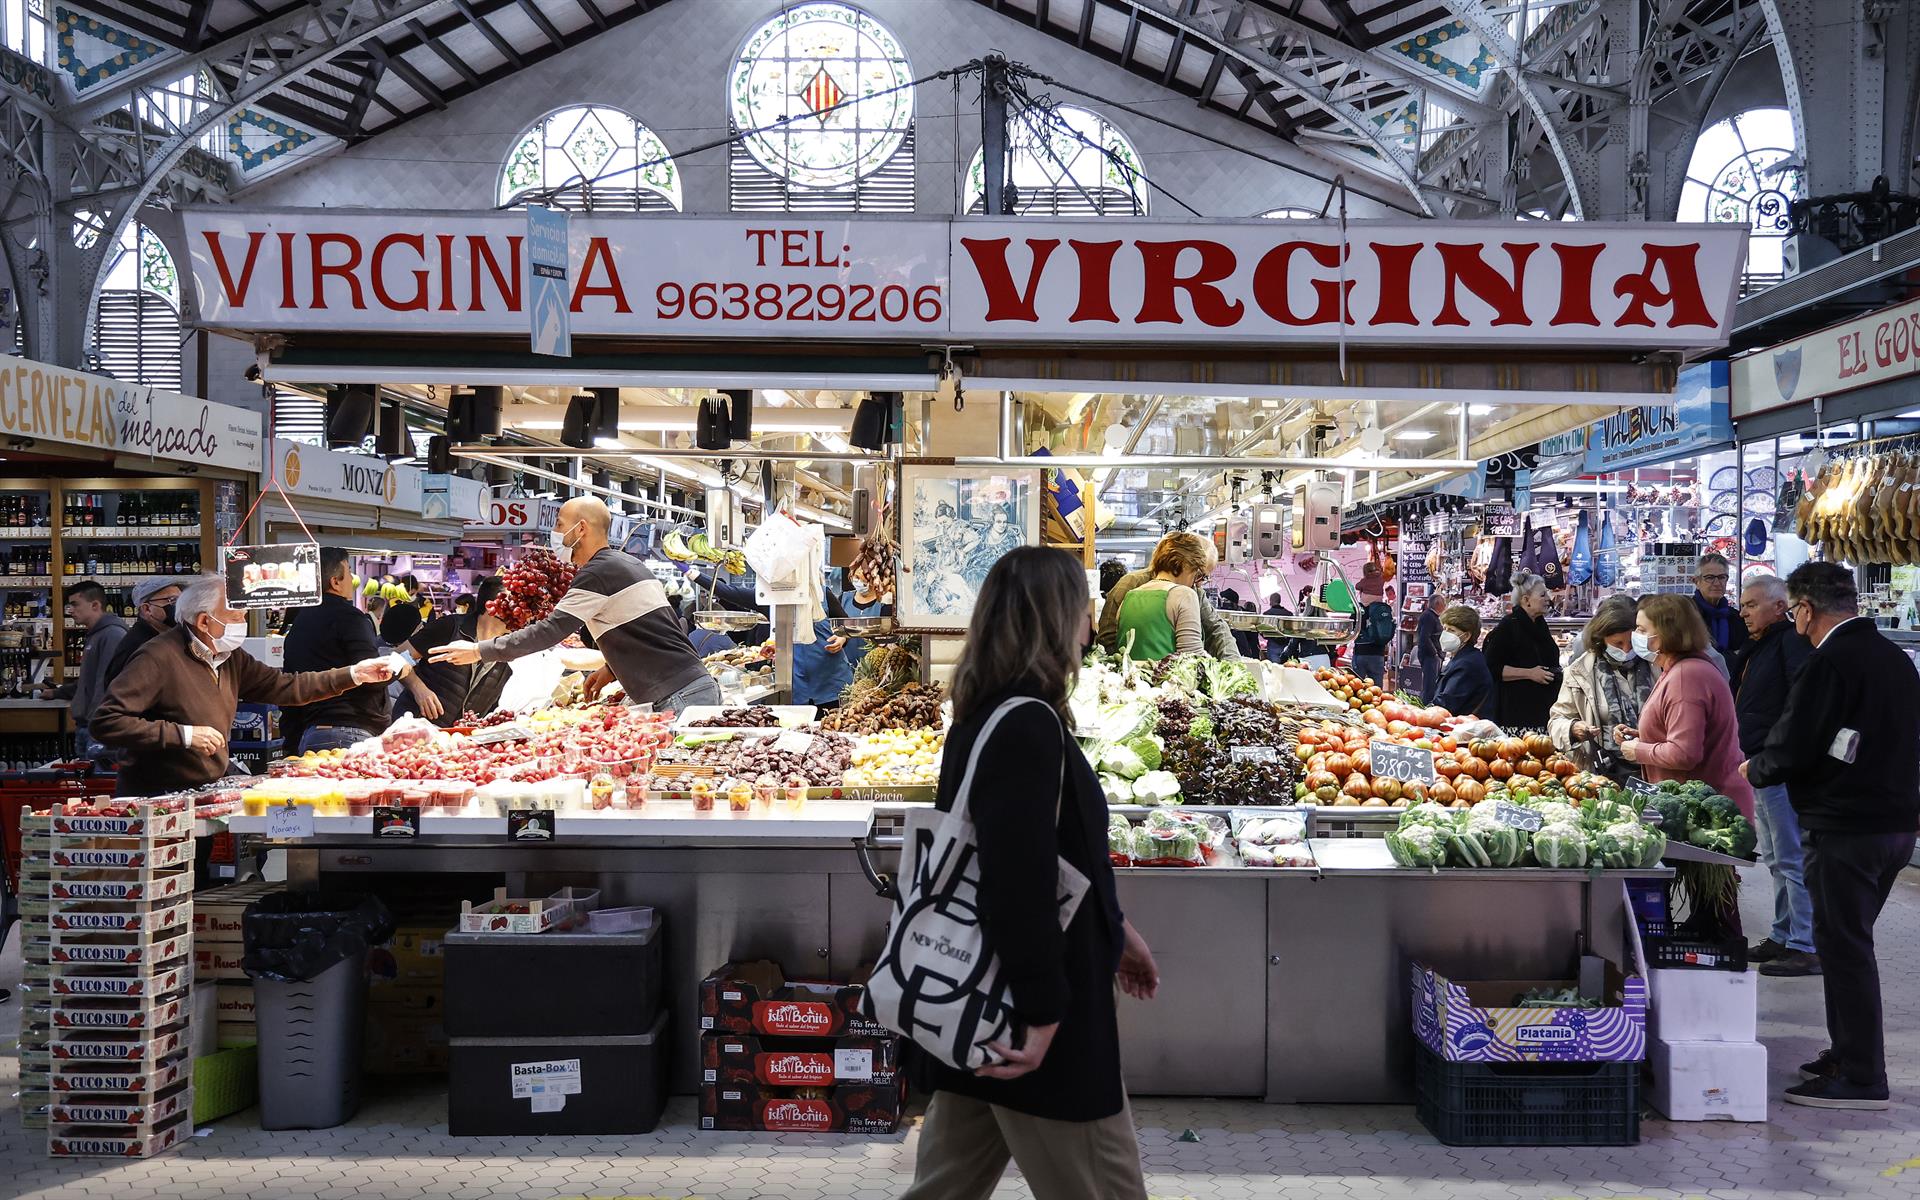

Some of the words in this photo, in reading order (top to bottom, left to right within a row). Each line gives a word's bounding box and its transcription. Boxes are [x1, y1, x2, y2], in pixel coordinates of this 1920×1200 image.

[746, 229, 851, 268] TEL:
[202, 230, 633, 313] VIRGINA
[960, 237, 1719, 328] VIRGINIA
[656, 281, 942, 322] 963829206
[1837, 331, 1868, 379] EL
[0, 365, 117, 448] CERVEZAS
[118, 391, 139, 416] del
[120, 404, 218, 458] mercado
[71, 819, 100, 832] CUCO
[104, 820, 128, 832] SUD
[71, 852, 101, 864] CUCO
[104, 852, 128, 865] SUD
[69, 884, 100, 896] CUCO
[103, 884, 127, 896] SUD
[69, 915, 100, 927] CUCO
[103, 915, 125, 927] SUD
[69, 947, 100, 959] CUCO
[103, 947, 126, 960] SUD
[910, 930, 932, 947] NEW
[933, 940, 972, 965] YORKER
[71, 979, 101, 992] CUCO
[104, 980, 128, 993] SUD
[217, 1001, 255, 1011] uchey
[71, 1012, 101, 1024] CUCO
[105, 1012, 129, 1025] SUD
[767, 1008, 784, 1022] isla
[793, 1007, 829, 1024] Bonita
[1520, 1028, 1571, 1038] Platania
[70, 1044, 101, 1056] CUCO
[104, 1044, 128, 1056] SUD
[514, 1063, 566, 1076] Basta-Box
[770, 1060, 787, 1073] isla
[795, 1058, 831, 1074] Bonita
[71, 1076, 101, 1088] CUCO
[105, 1076, 129, 1089] SUD
[70, 1108, 101, 1120] CUCO
[104, 1108, 128, 1121] SUD
[767, 1107, 784, 1121] isla
[793, 1106, 828, 1122] Bonita
[68, 1141, 100, 1153] CUCO
[103, 1141, 126, 1153] SUD
